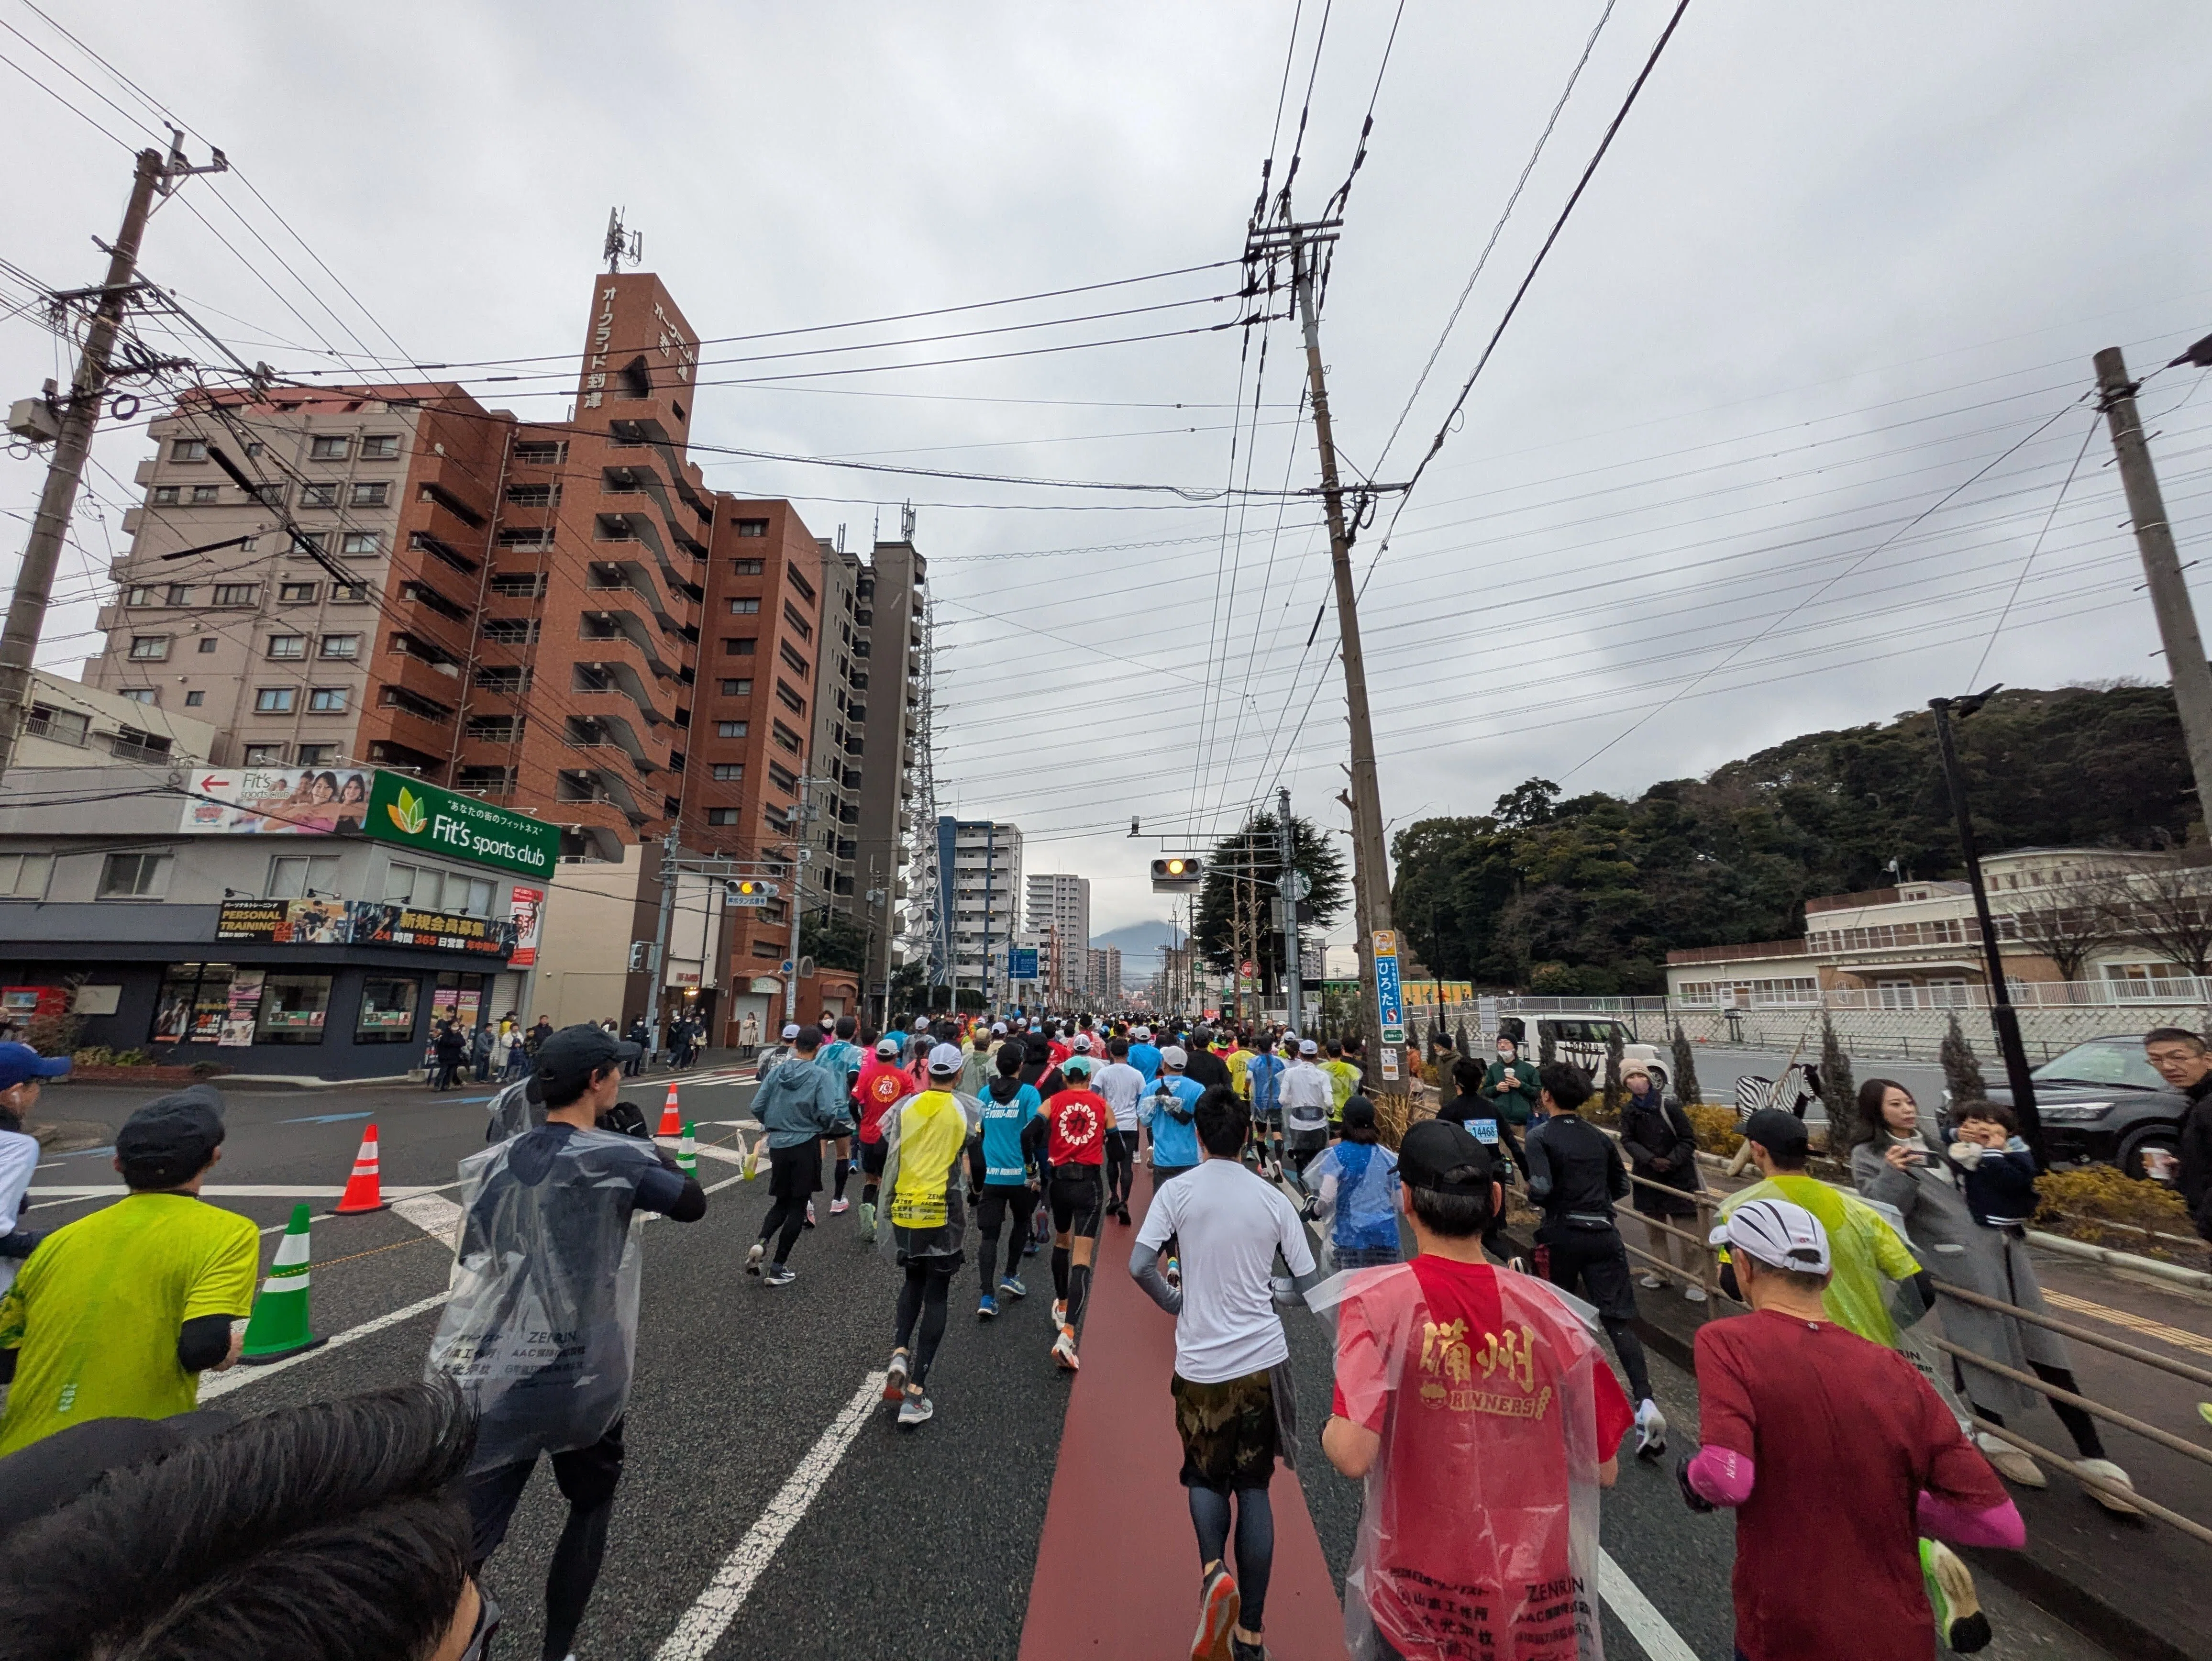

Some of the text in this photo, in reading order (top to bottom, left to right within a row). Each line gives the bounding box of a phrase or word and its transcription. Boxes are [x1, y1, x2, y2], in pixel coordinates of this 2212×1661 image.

[243, 773, 271, 788] Fit's
[241, 790, 268, 799] sports
[432, 814, 545, 866] Fit's sports club
[222, 910, 281, 920] PERSONAL
[220, 921, 276, 930] TRAINING
[399, 910, 485, 938] 新規会員募集
[1378, 962, 1394, 1006] ひろた
[1472, 1126, 1495, 1138] 14468
[1525, 1577, 1585, 1603] ZENRIN
